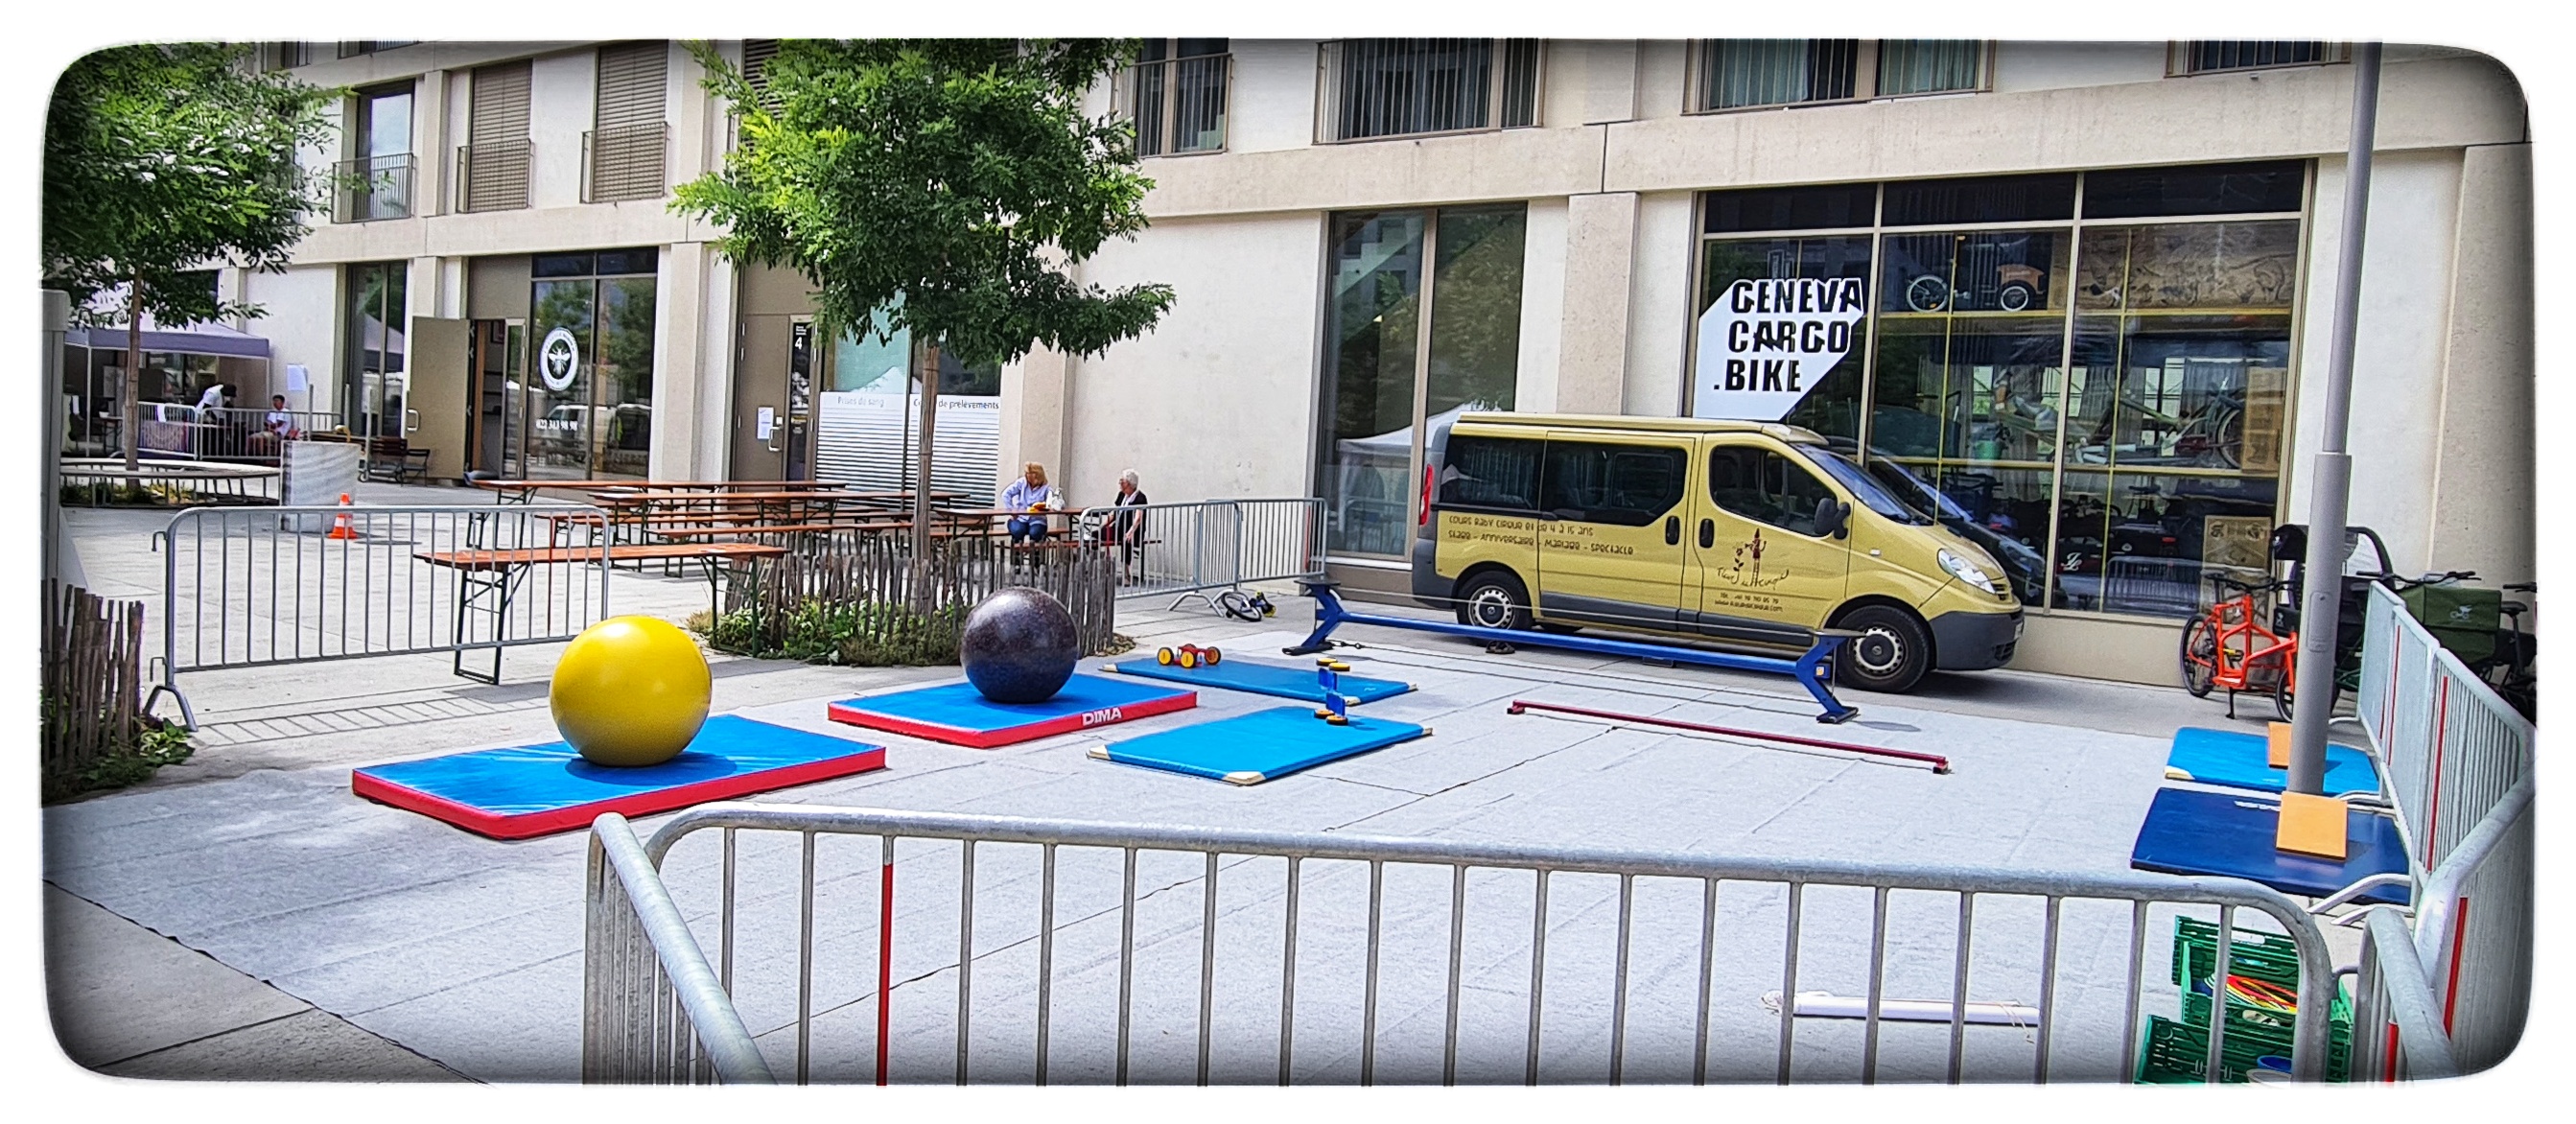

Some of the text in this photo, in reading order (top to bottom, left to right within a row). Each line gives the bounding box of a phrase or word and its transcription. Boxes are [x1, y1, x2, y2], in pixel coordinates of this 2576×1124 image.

[1730, 279, 1862, 314] GENEVA
[794, 337, 803, 350] 4
[1728, 319, 1850, 353] CARGO
[1713, 359, 1802, 392] .BIKE
[938, 398, 948, 408] de
[1081, 707, 1122, 726] DIMA
